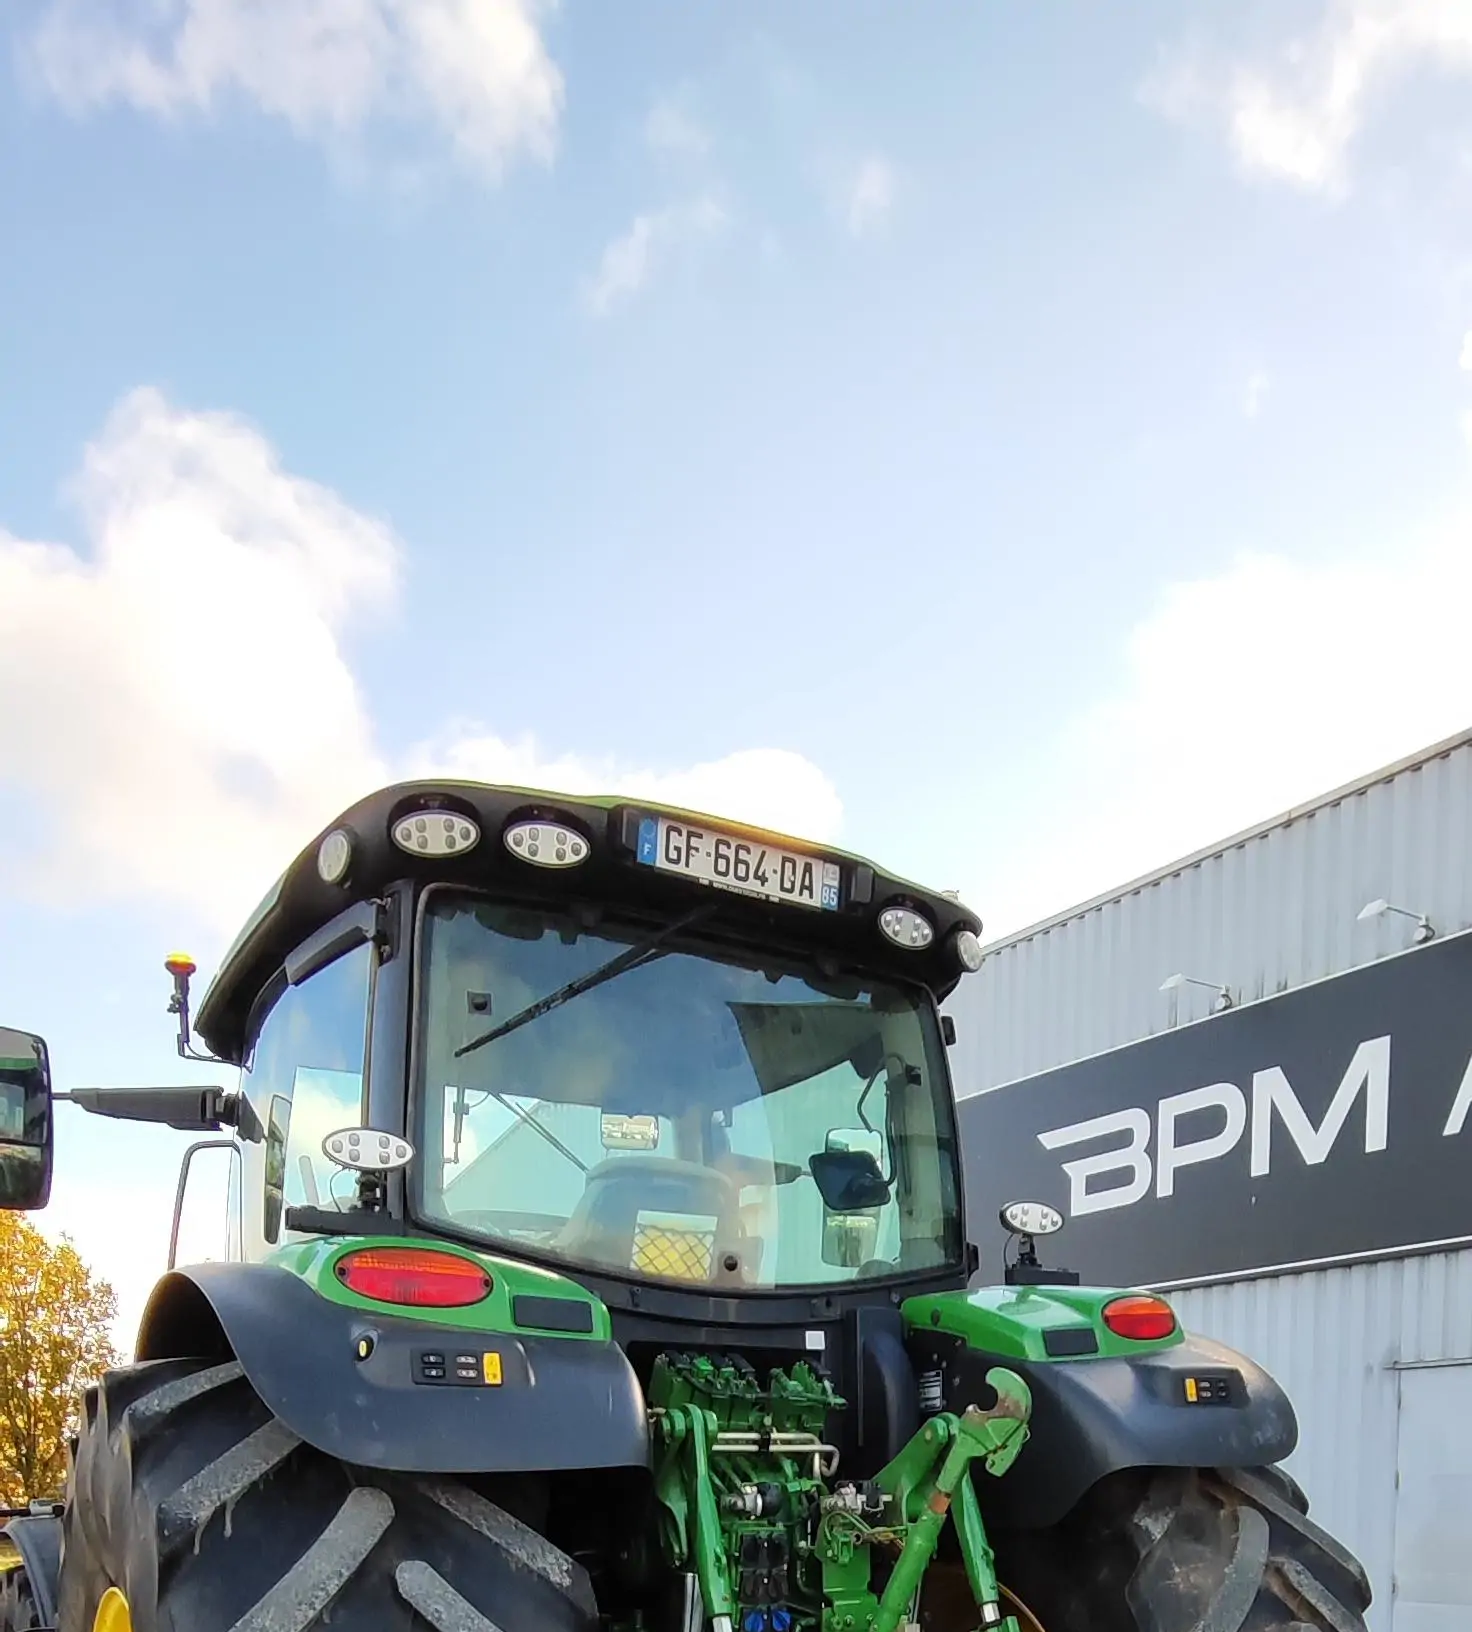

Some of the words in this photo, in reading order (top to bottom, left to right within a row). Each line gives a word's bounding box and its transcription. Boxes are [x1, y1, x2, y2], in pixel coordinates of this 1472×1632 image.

[644, 844, 651, 856] F
[822, 886, 838, 905] 85
[1036, 1034, 1391, 1216] BPM
